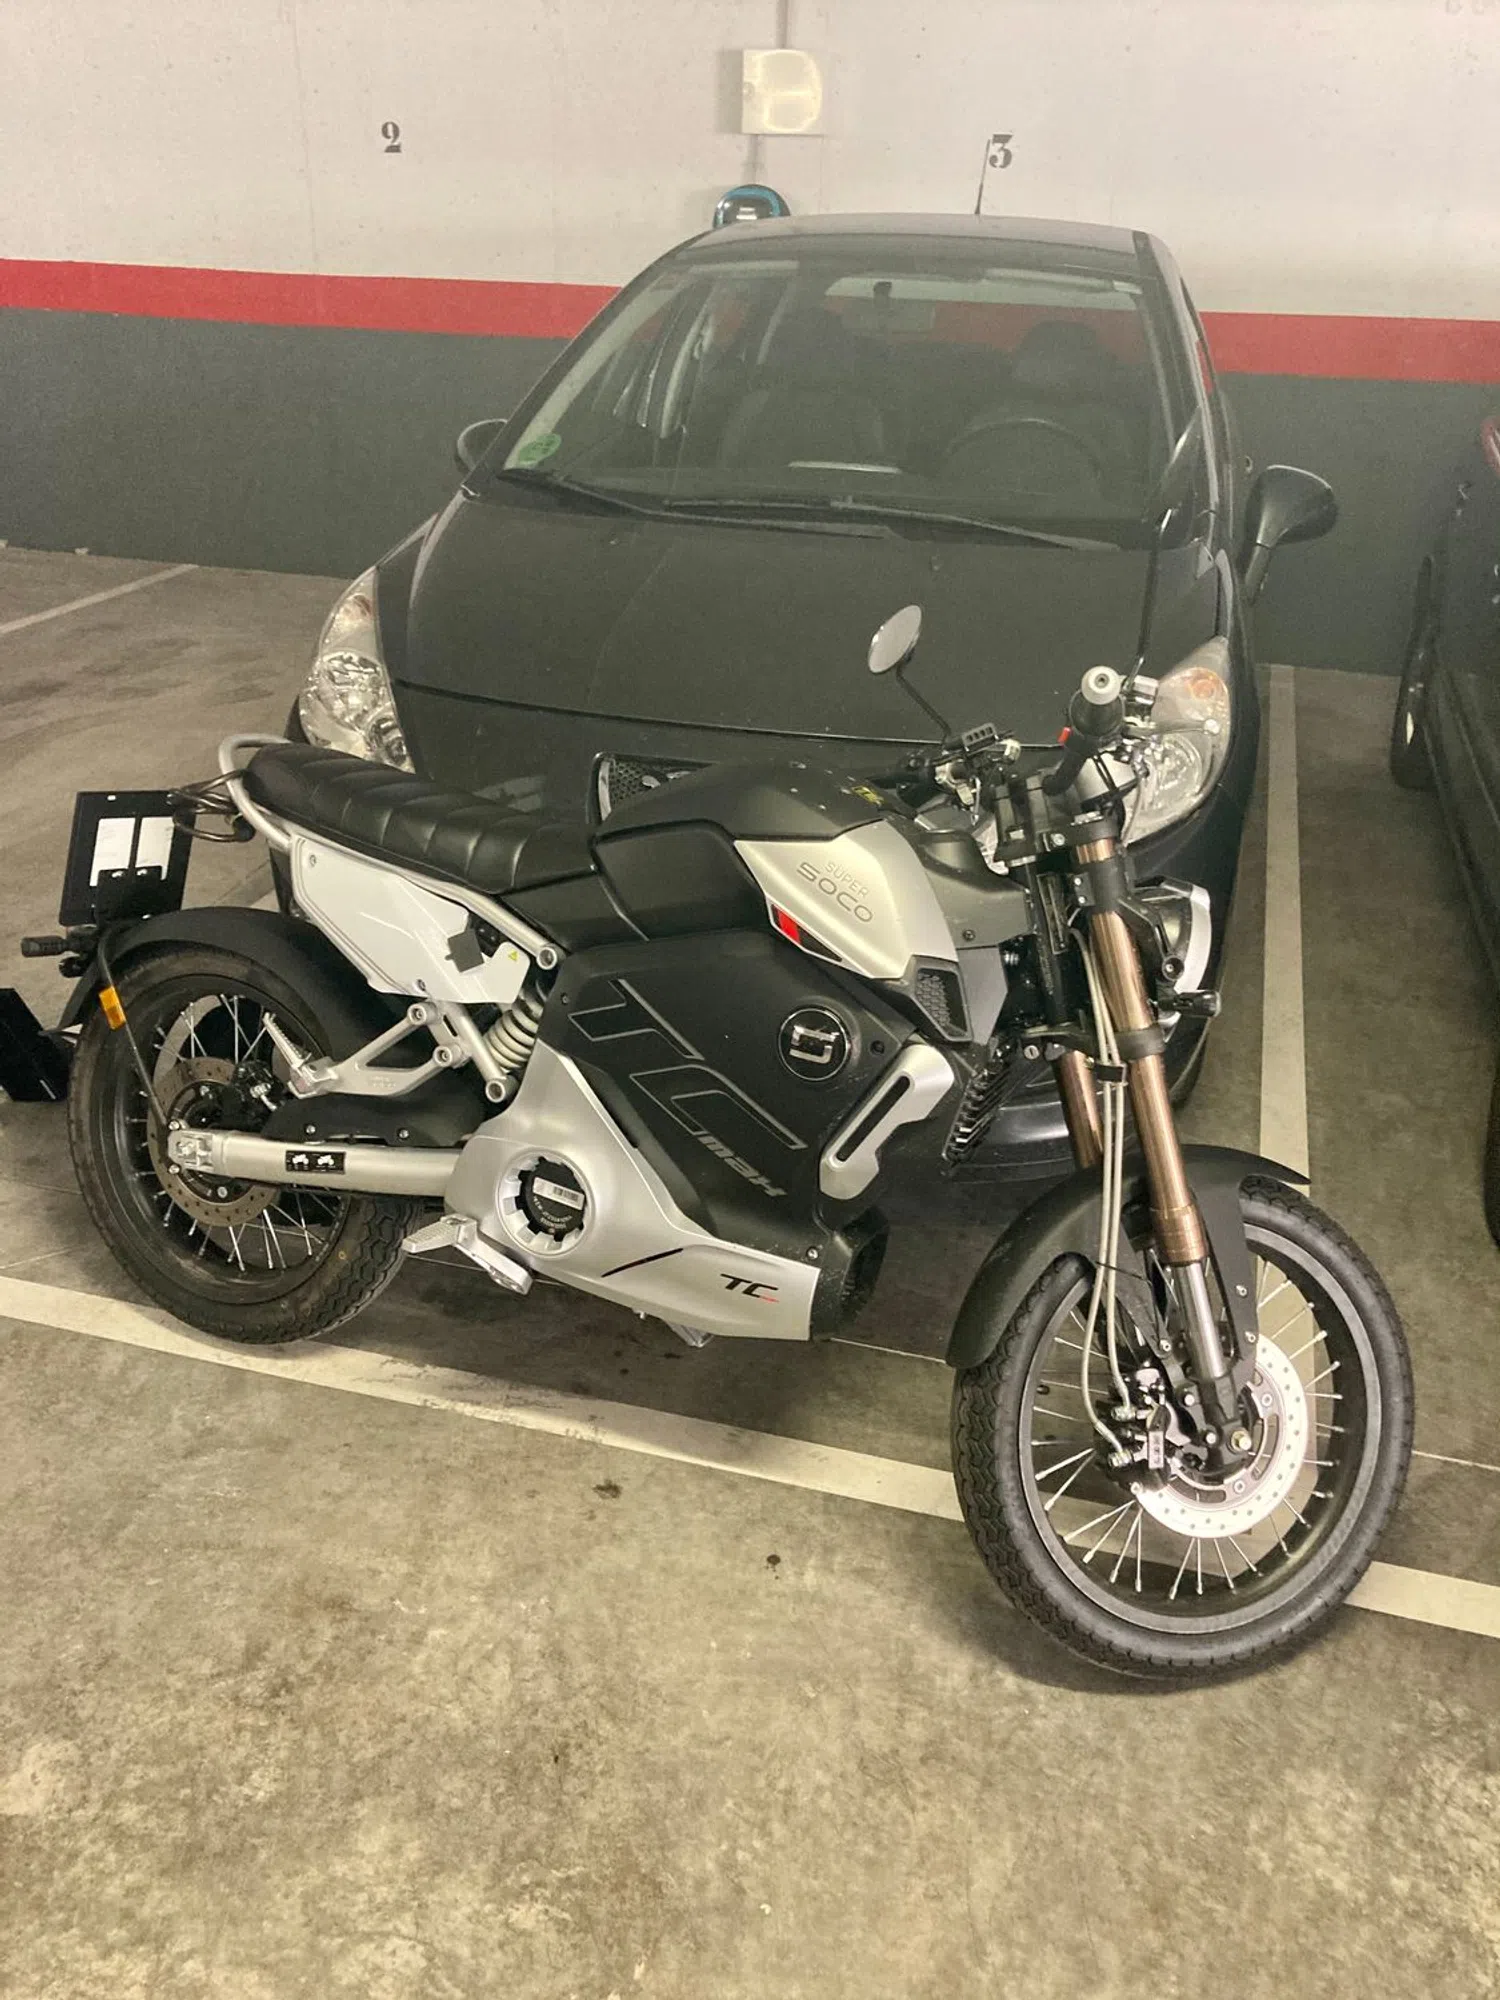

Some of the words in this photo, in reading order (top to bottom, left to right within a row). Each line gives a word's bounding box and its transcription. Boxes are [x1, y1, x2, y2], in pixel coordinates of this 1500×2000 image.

[381, 121, 402, 153] 2
[989, 133, 1012, 169] 3
[796, 861, 874, 923] SOCO
[824, 861, 870, 898] SUPER
[720, 1273, 779, 1303] TC
